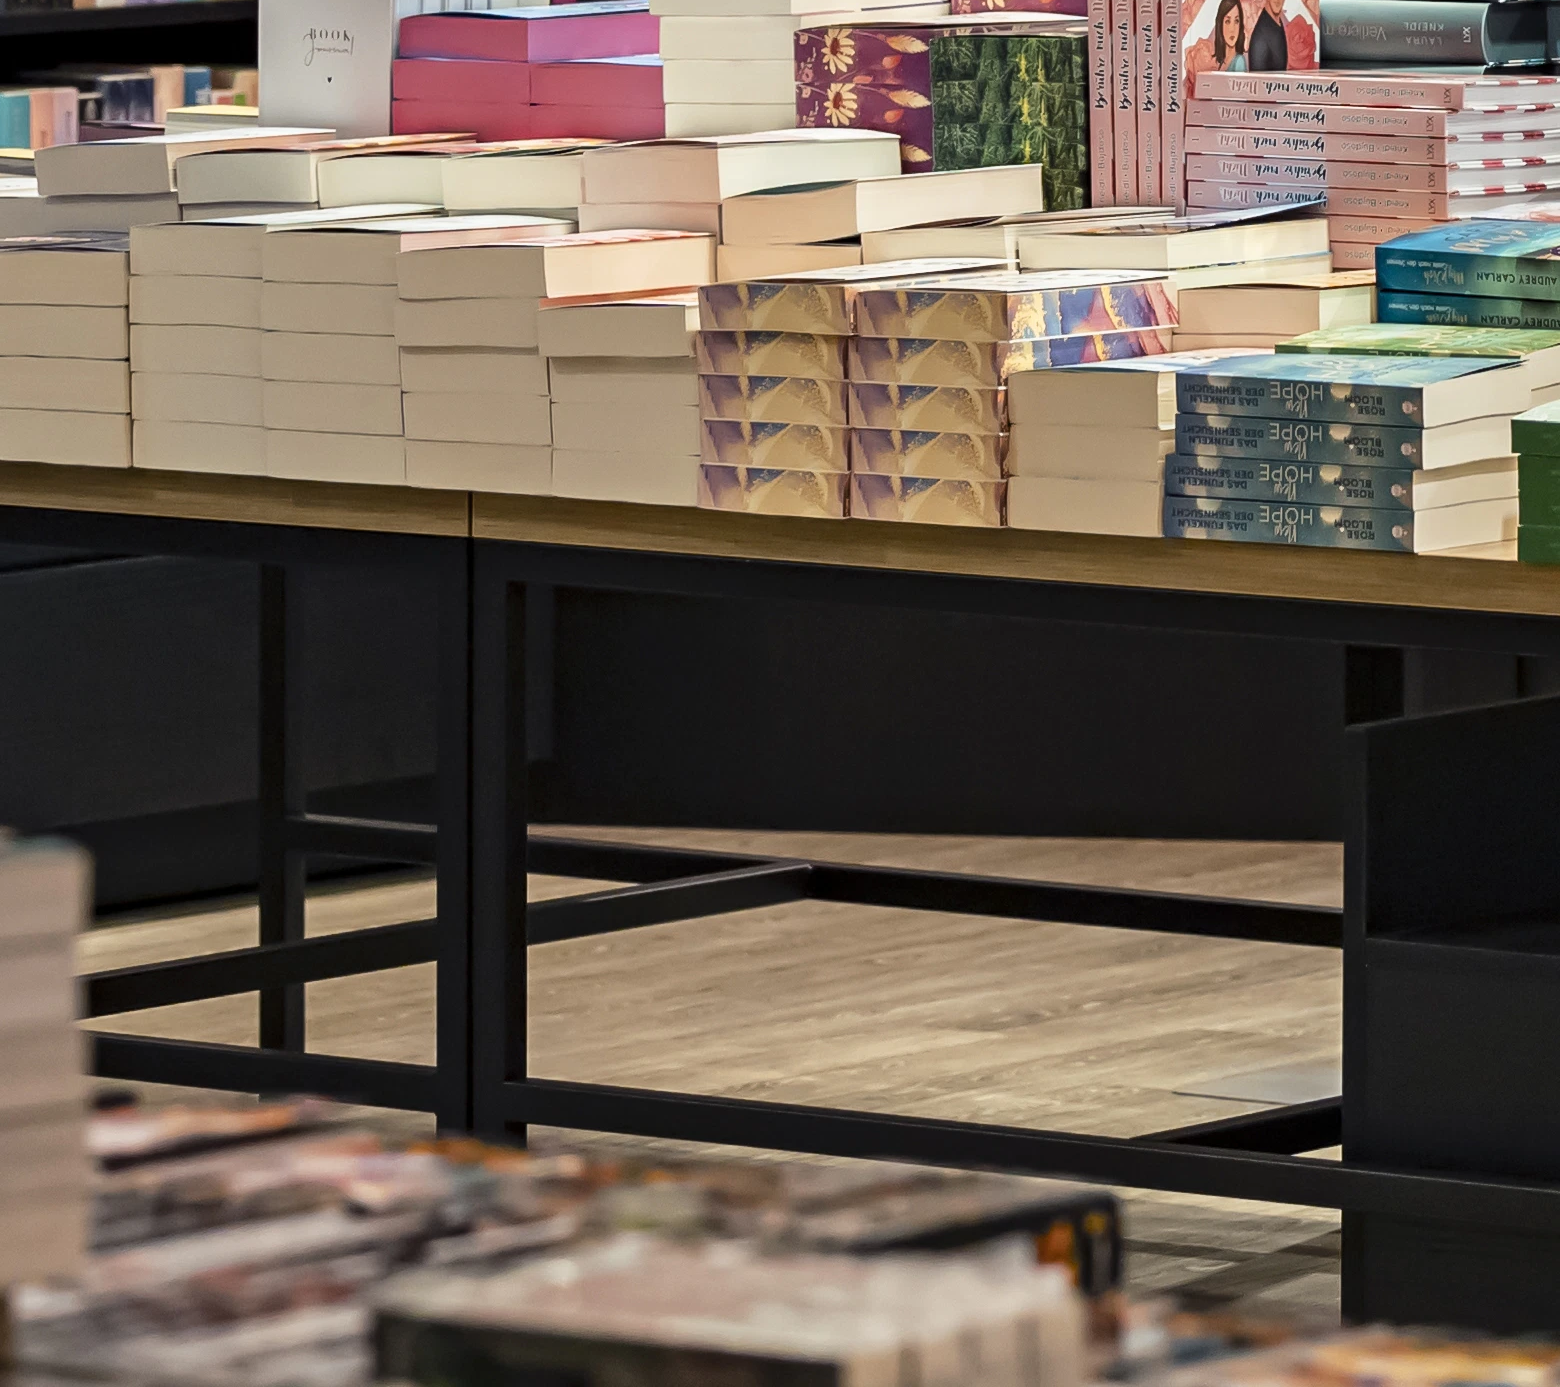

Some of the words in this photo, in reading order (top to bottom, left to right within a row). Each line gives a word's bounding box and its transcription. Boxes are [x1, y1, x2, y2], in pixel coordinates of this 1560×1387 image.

[1403, 21, 1444, 31] KNEIDL
[309, 28, 351, 41] BOOK
[1096, 17, 1105, 50] mich.
[1120, 18, 1128, 51] mich.
[1404, 36, 1442, 45] LAURA
[1462, 27, 1472, 43] LYX
[1095, 56, 1108, 109] Berühre
[1119, 57, 1132, 110] Berühre
[1263, 80, 1290, 94] mich.
[1294, 81, 1339, 98] Berühre
[1443, 87, 1452, 103] LYX
[1251, 108, 1277, 122] mich.
[1283, 108, 1326, 125] Berühre
[1426, 116, 1435, 132] LYX
[1250, 136, 1277, 150] mich.
[1283, 136, 1325, 153] Berühre
[1476, 272, 1516, 283] CARLAN
[1520, 276, 1557, 286] AUDREY
[1480, 314, 1521, 326] CARLAN
[1183, 383, 1240, 396] SEHNSUCHT
[1242, 387, 1265, 397] DER
[1269, 381, 1323, 403] HOPE
[1190, 395, 1236, 406] FUNKELN
[1240, 397, 1259, 407] DAS
[1344, 394, 1383, 405] BLOOM
[1357, 405, 1386, 416] ROSE
[1268, 422, 1323, 442] HOPE
[1258, 464, 1313, 483] HOPE
